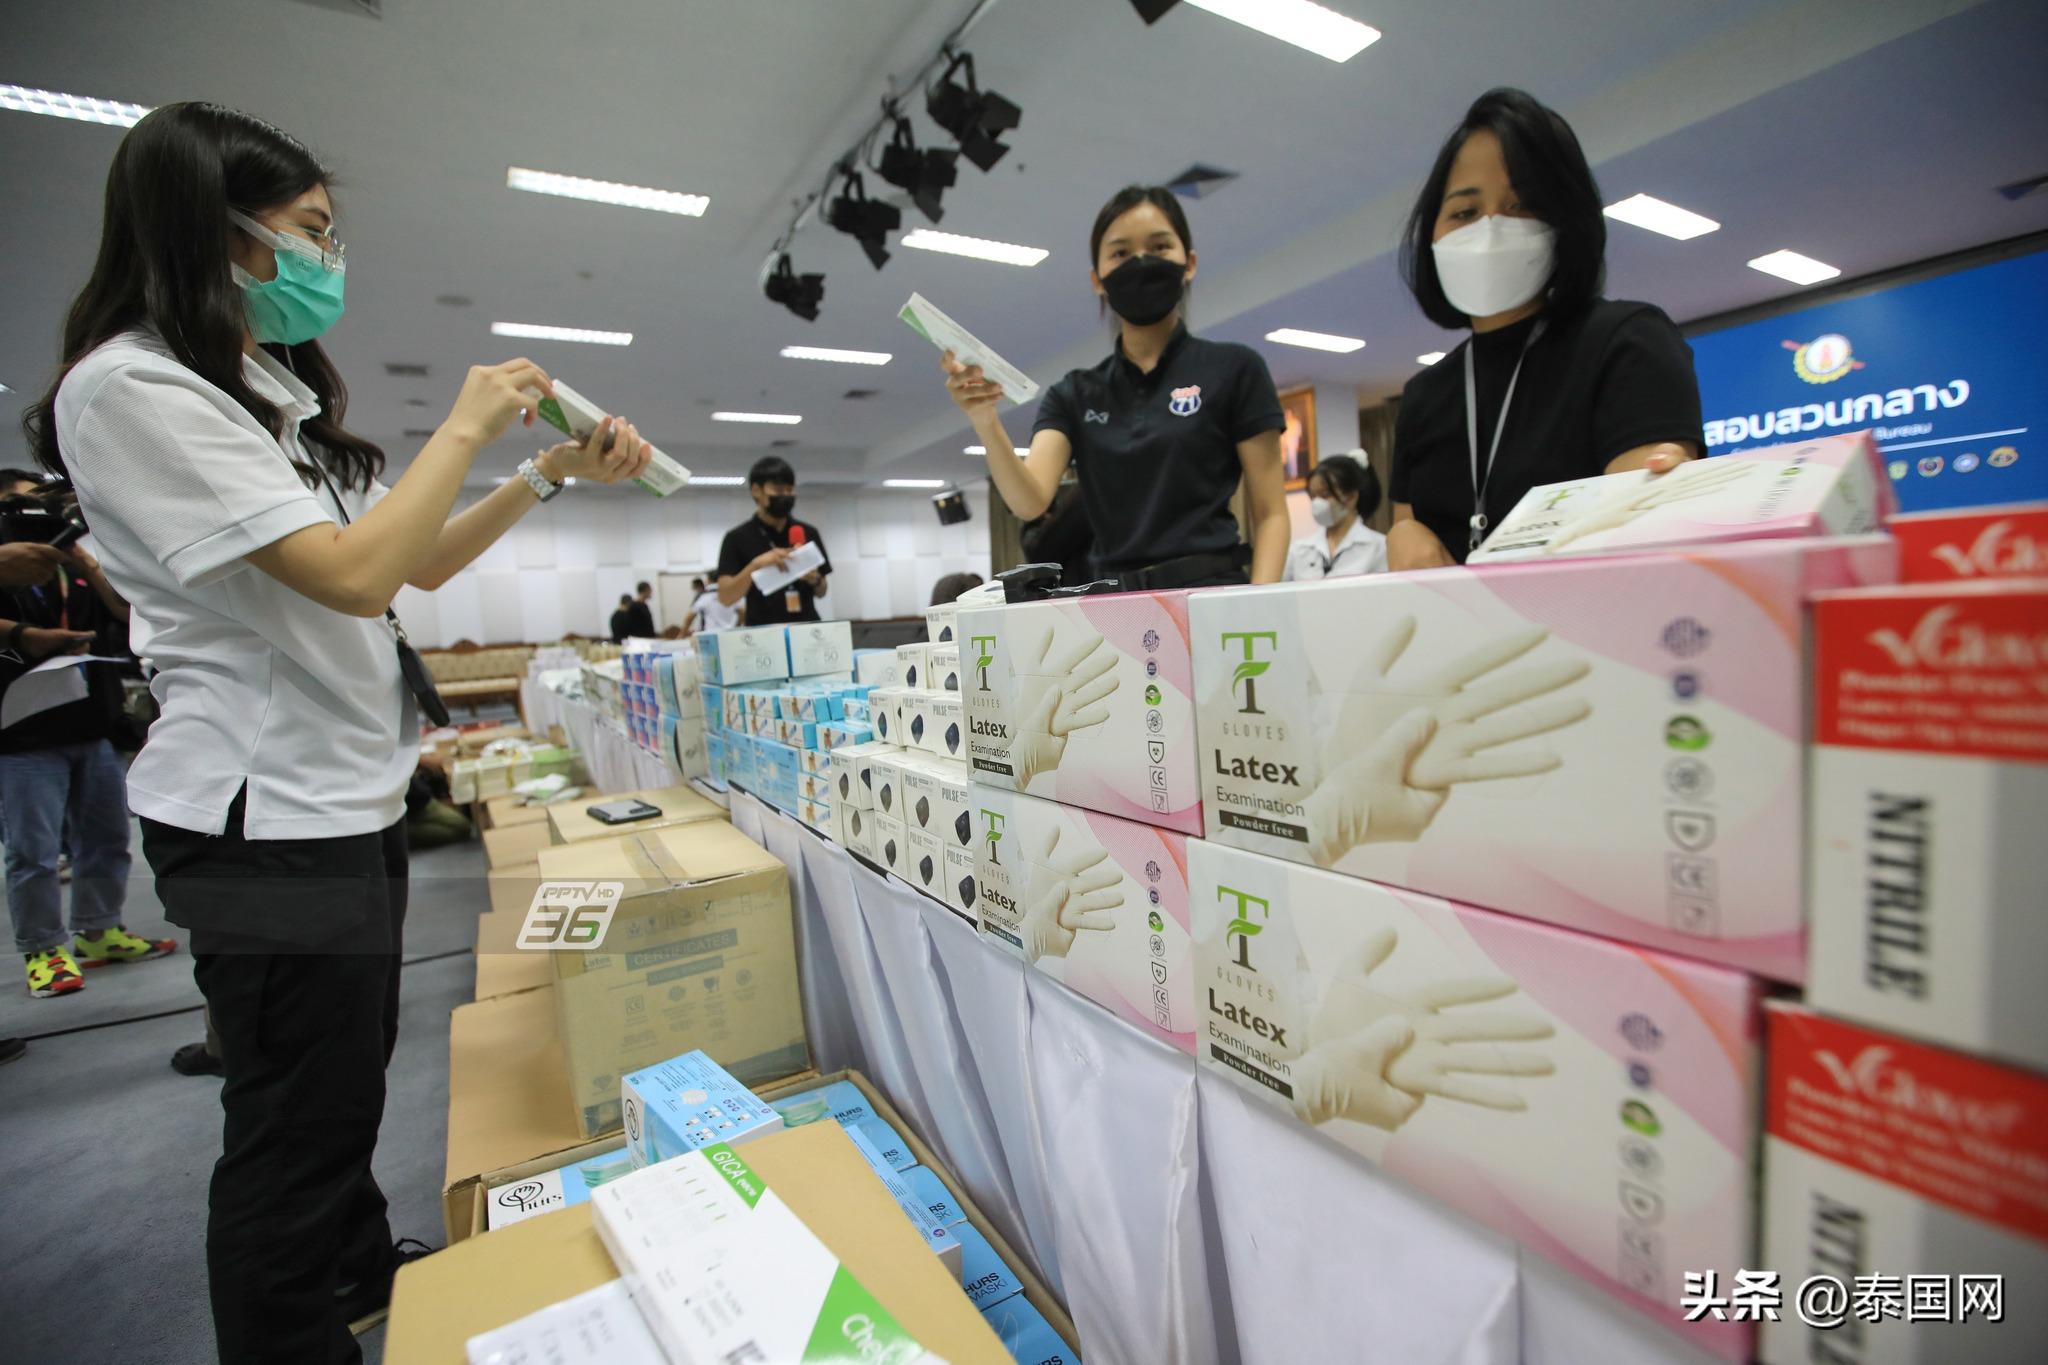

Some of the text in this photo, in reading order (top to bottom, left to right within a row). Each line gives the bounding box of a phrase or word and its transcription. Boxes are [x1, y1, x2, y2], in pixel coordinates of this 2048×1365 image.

[969, 715, 1008, 739] Latex
[1222, 722, 1285, 742] GLOVES
[970, 741, 1011, 759] Examination
[1214, 748, 1301, 787] Latex
[941, 787, 960, 803] PULSE
[1216, 786, 1306, 817] Examination
[1233, 815, 1295, 838] Powder free
[980, 880, 1018, 915] Latex
[1867, 787, 1932, 1002] NITRILE
[981, 903, 1021, 933] Examination
[1216, 965, 1275, 1003] GLOVES
[1208, 986, 1288, 1049] Latex
[1208, 1020, 1292, 1077] Examination
[1222, 1051, 1281, 1091] Powder free
[712, 1151, 747, 1180] GICA
[963, 1272, 999, 1294] HURS
